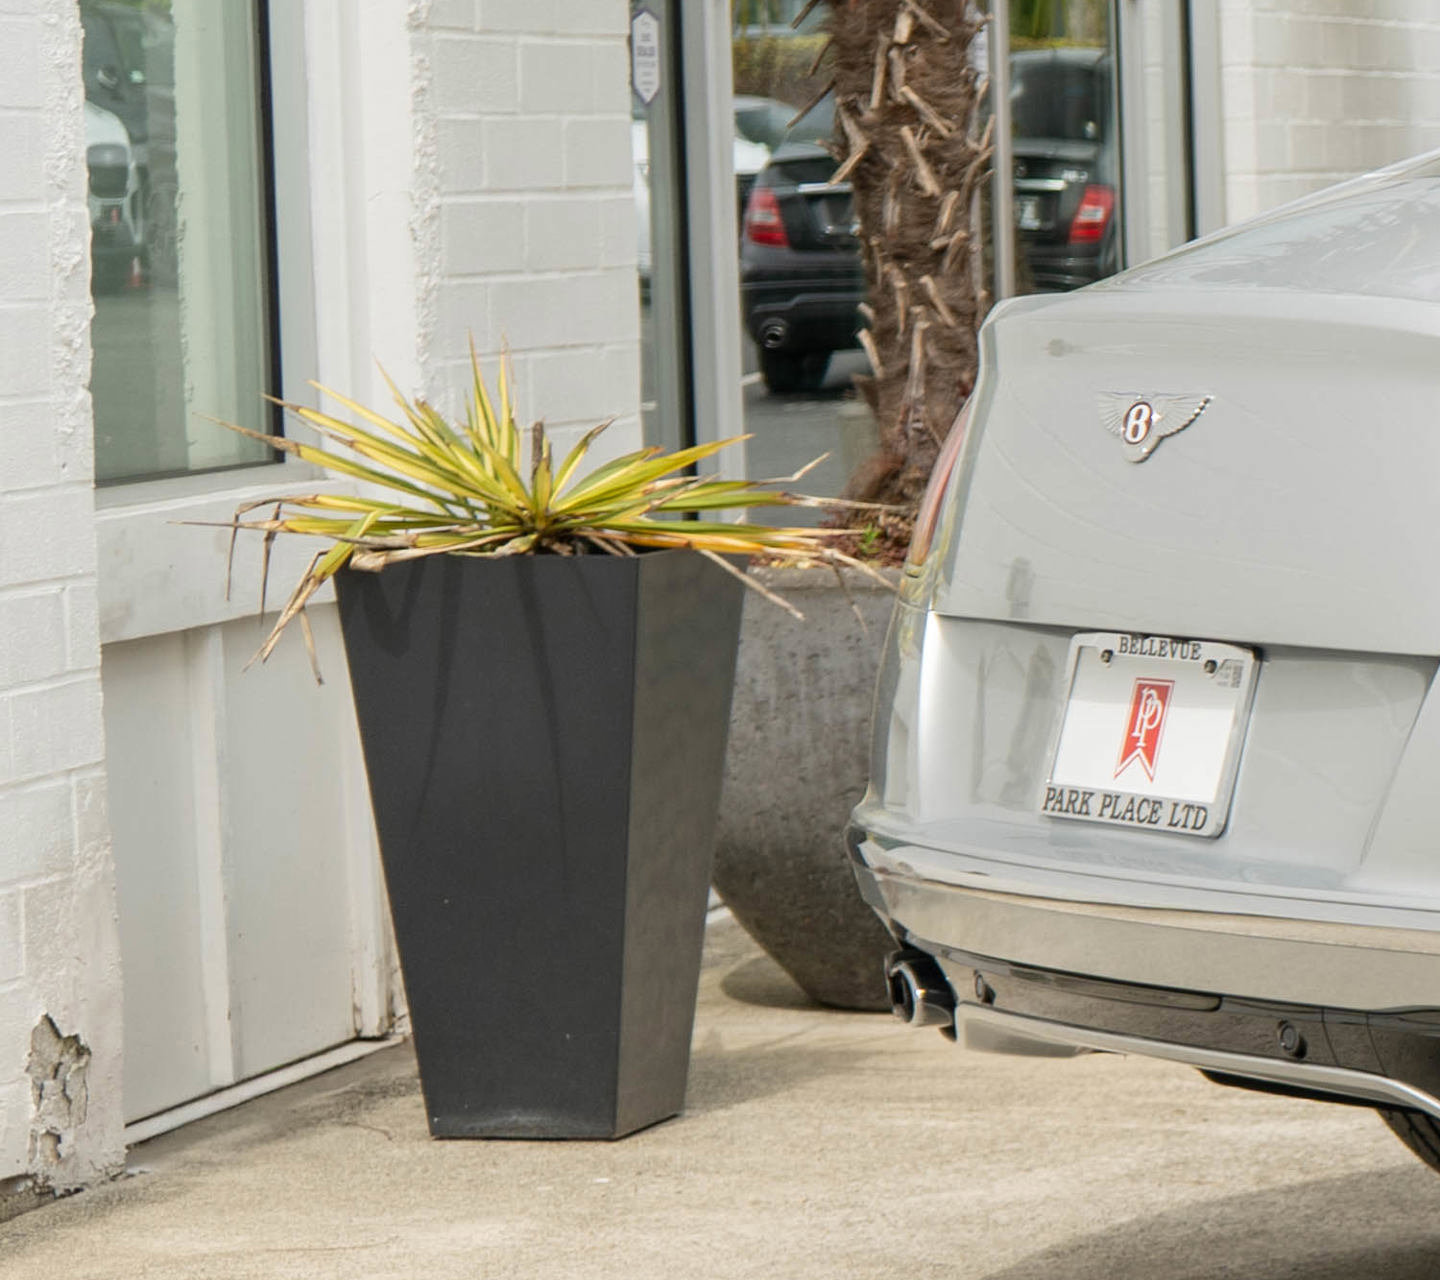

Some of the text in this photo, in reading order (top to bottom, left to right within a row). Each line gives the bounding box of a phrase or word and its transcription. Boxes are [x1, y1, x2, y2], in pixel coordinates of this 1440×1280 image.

[1118, 636, 1202, 661] BELLEVUE
[1042, 787, 1209, 831] PARK PLACE LTD
